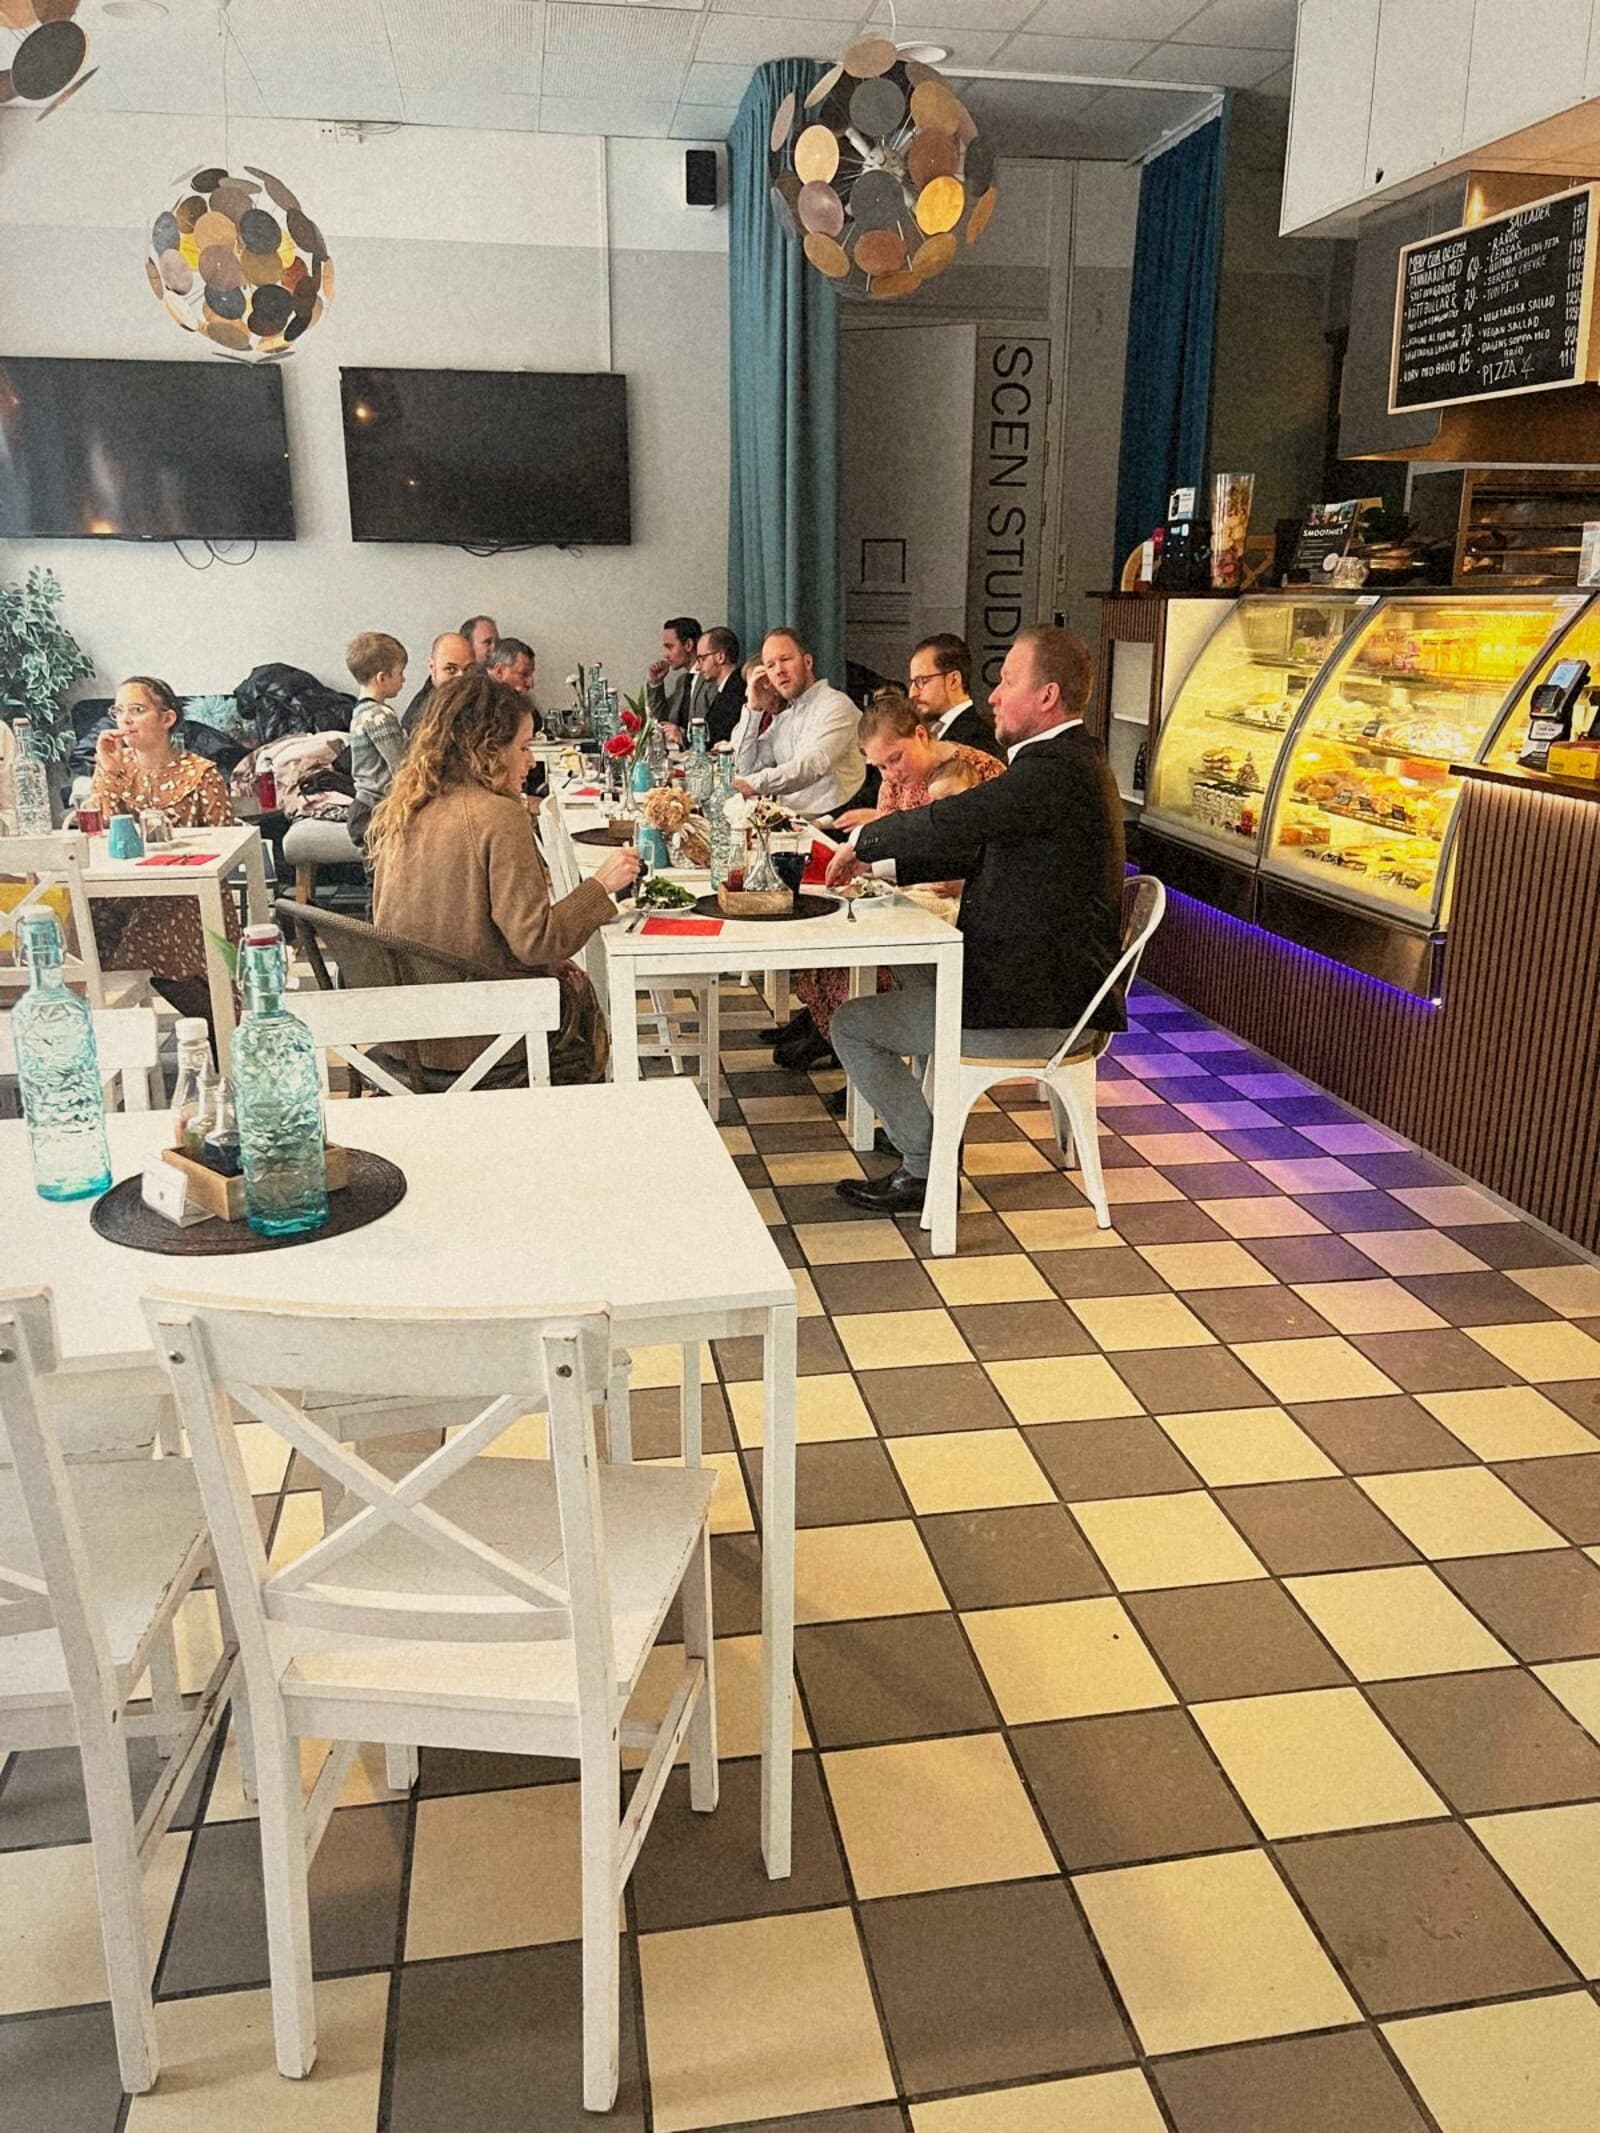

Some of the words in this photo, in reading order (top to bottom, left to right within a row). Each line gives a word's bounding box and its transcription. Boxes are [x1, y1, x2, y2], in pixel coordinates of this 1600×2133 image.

[1507, 204, 1551, 232] SALLADER
[1527, 294, 1556, 312] SALLAD
[1507, 315, 1540, 333] SALLAD
[1482, 359, 1518, 386] PIZZA
[988, 344, 1033, 487] SCEN
[1303, 526, 1344, 537] SMOOTHIES
